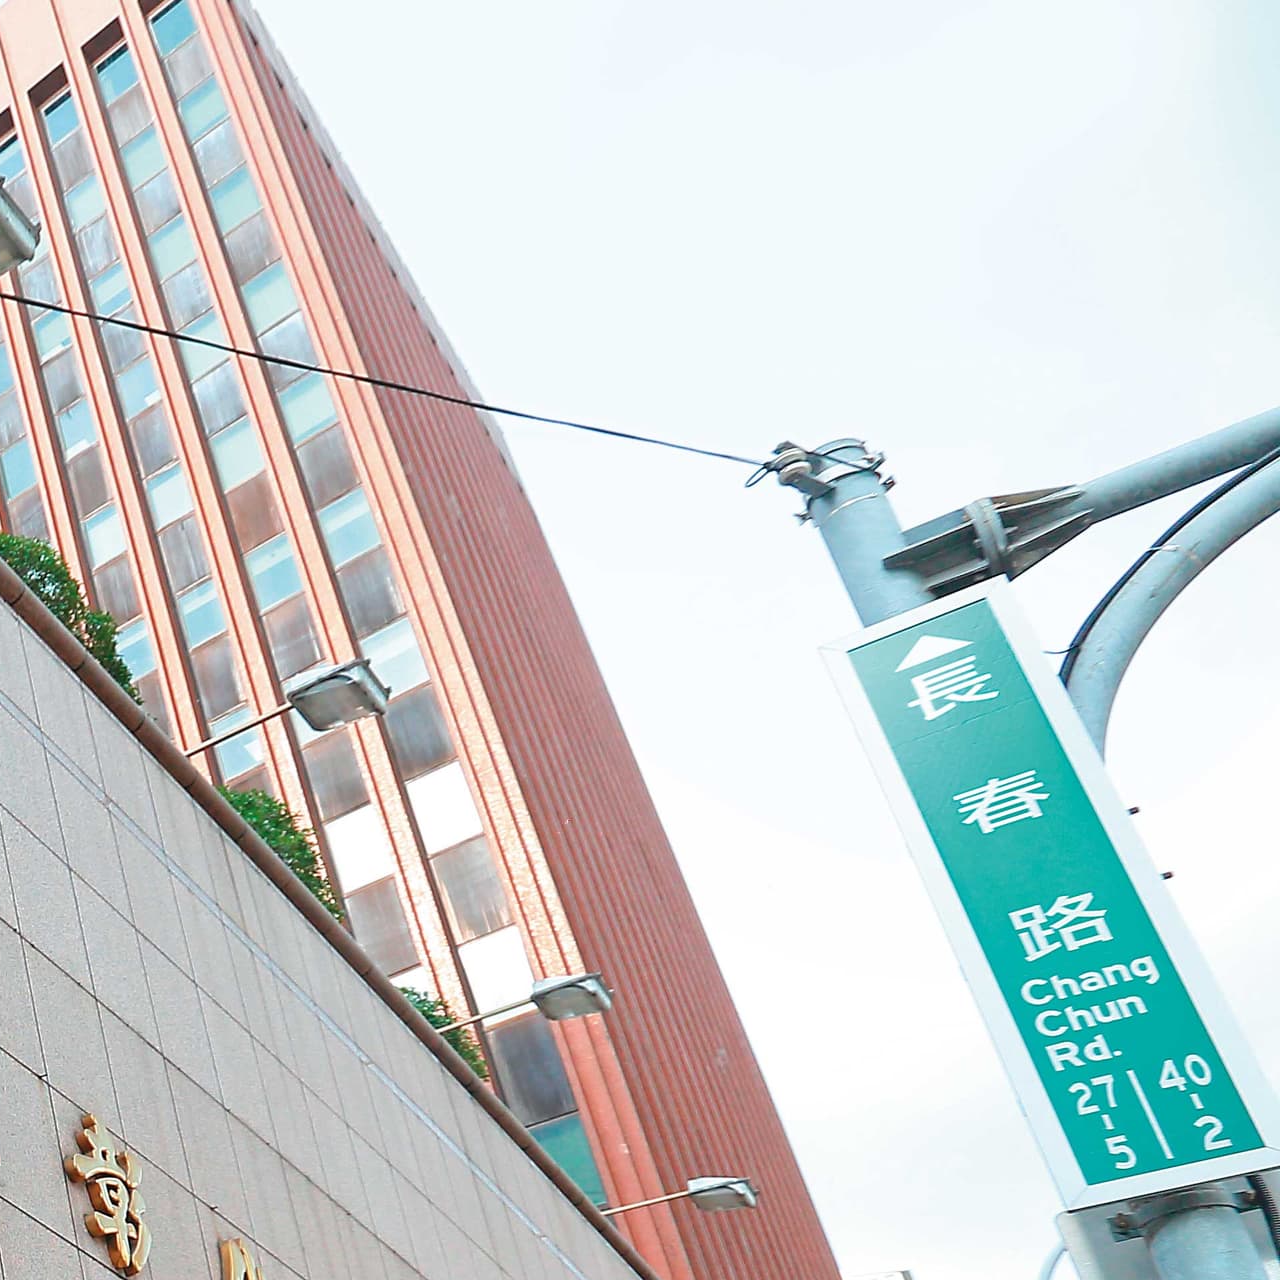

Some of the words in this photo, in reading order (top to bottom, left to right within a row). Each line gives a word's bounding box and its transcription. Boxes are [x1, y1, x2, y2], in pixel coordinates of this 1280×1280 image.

[907, 655, 1114, 962] 長春路
[1020, 954, 1161, 1006] Chang
[1034, 996, 1148, 1039] Chun
[1046, 1040, 1123, 1074] Rd.
